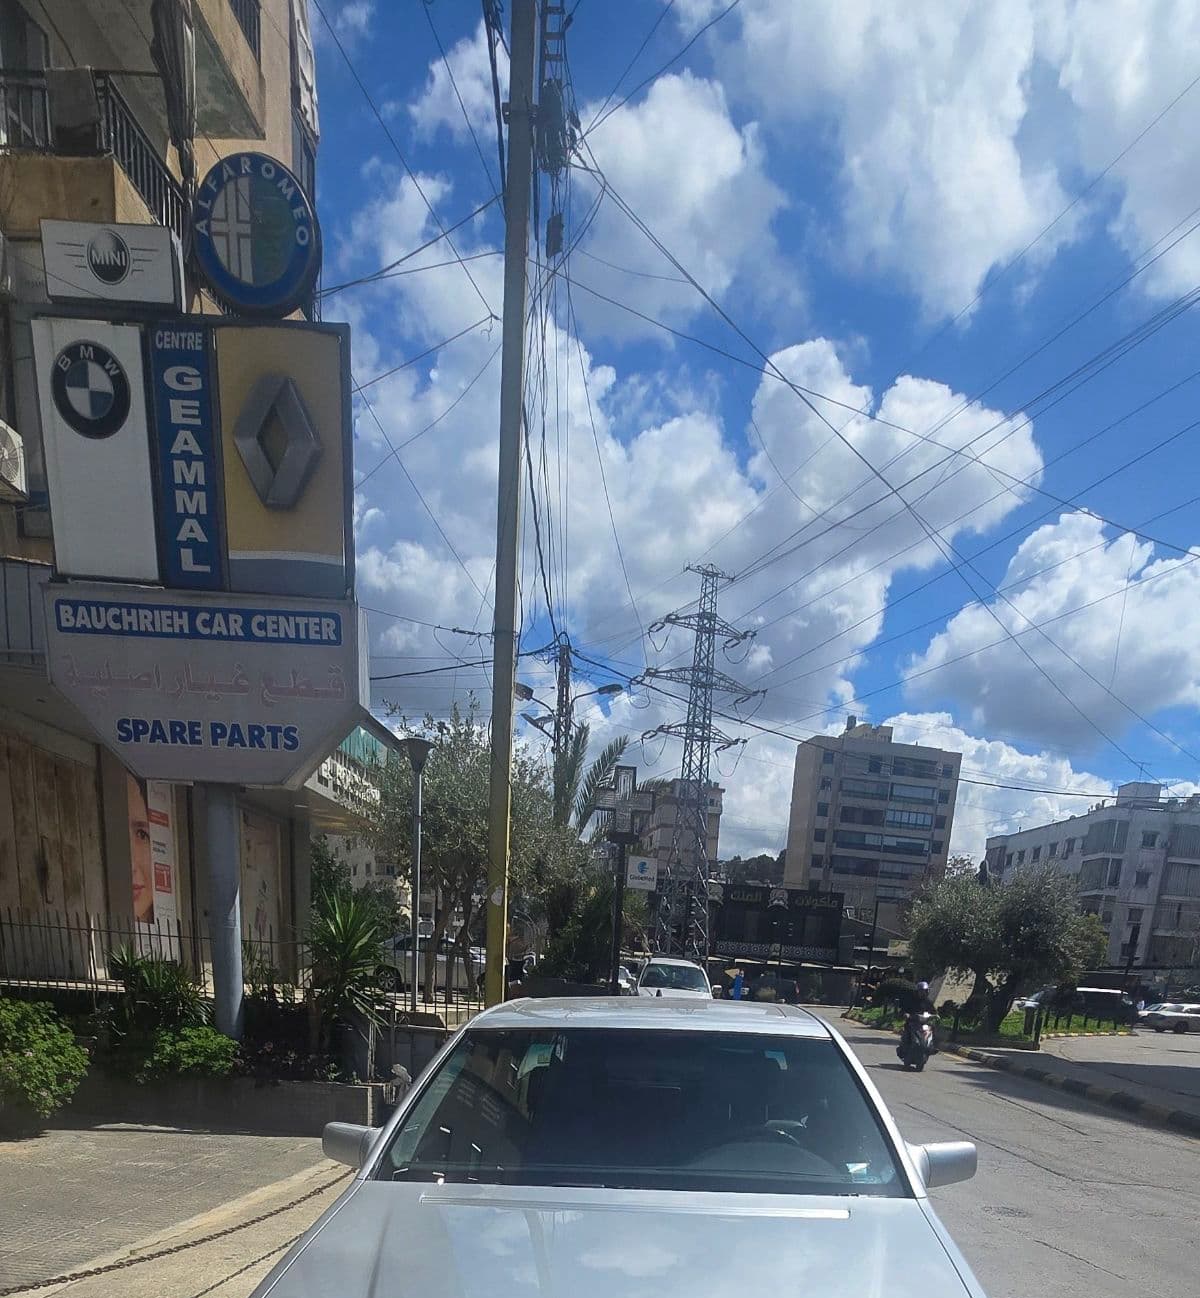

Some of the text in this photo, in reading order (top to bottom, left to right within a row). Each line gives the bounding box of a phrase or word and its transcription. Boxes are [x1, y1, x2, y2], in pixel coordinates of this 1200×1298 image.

[90, 249, 129, 267] MINI
[155, 330, 203, 351] CENTRE
[57, 344, 120, 378] BMW
[164, 365, 211, 573] GEAMMAL
[59, 604, 337, 641] BAUCHRIEH CAR CENTER
[168, 662, 250, 702] غيار
[260, 664, 347, 706] قطع
[117, 718, 299, 751] SPARE PARTS
